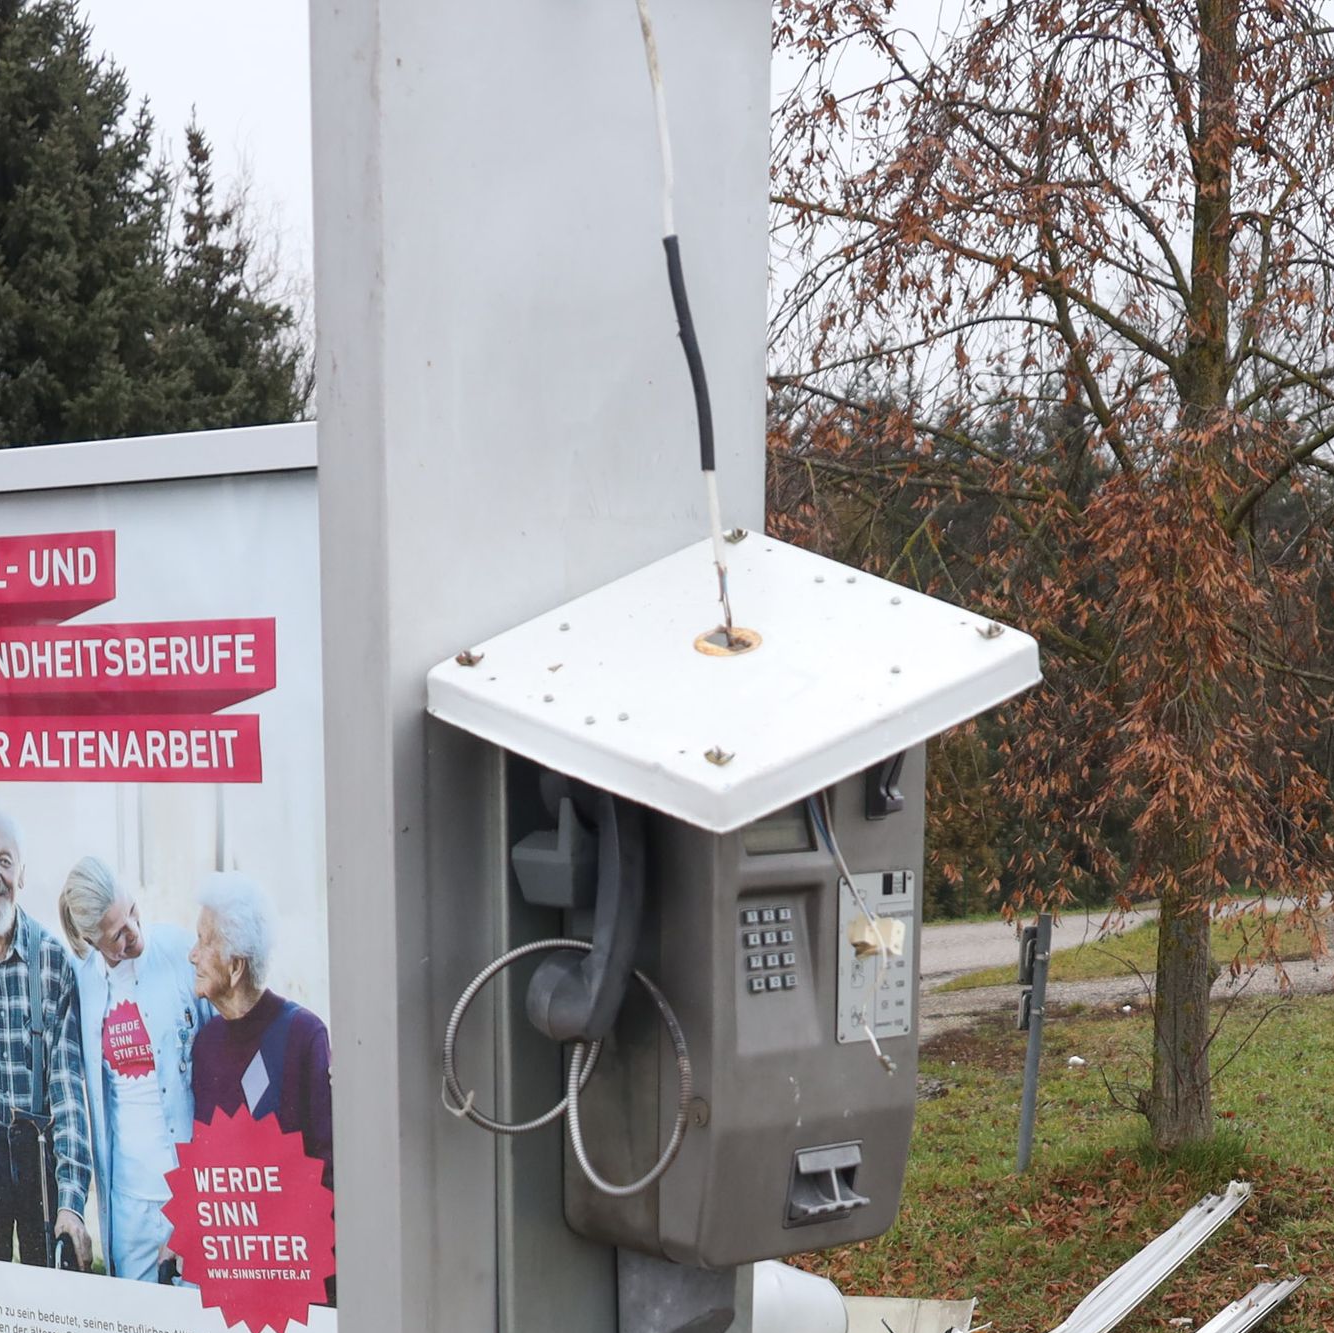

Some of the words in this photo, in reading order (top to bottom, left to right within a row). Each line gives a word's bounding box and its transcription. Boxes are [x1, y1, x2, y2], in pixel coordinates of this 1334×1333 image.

[29, 546, 97, 587] UND
[18, 729, 239, 769] ALTENARBEIT
[108, 1019, 140, 1035] WERDE
[109, 1035, 133, 1048] SINN
[193, 1166, 282, 1193] WERDE
[197, 1201, 259, 1227] SINN
[202, 1235, 308, 1262] STIFTER
[207, 1267, 311, 1281] WWW.SINNSTIFTER.AT
[5, 1306, 15, 1317] zu
[17, 1307, 36, 1321] sein
[38, 1309, 81, 1329] bedeutet,
[83, 1317, 115, 1332] seinen
